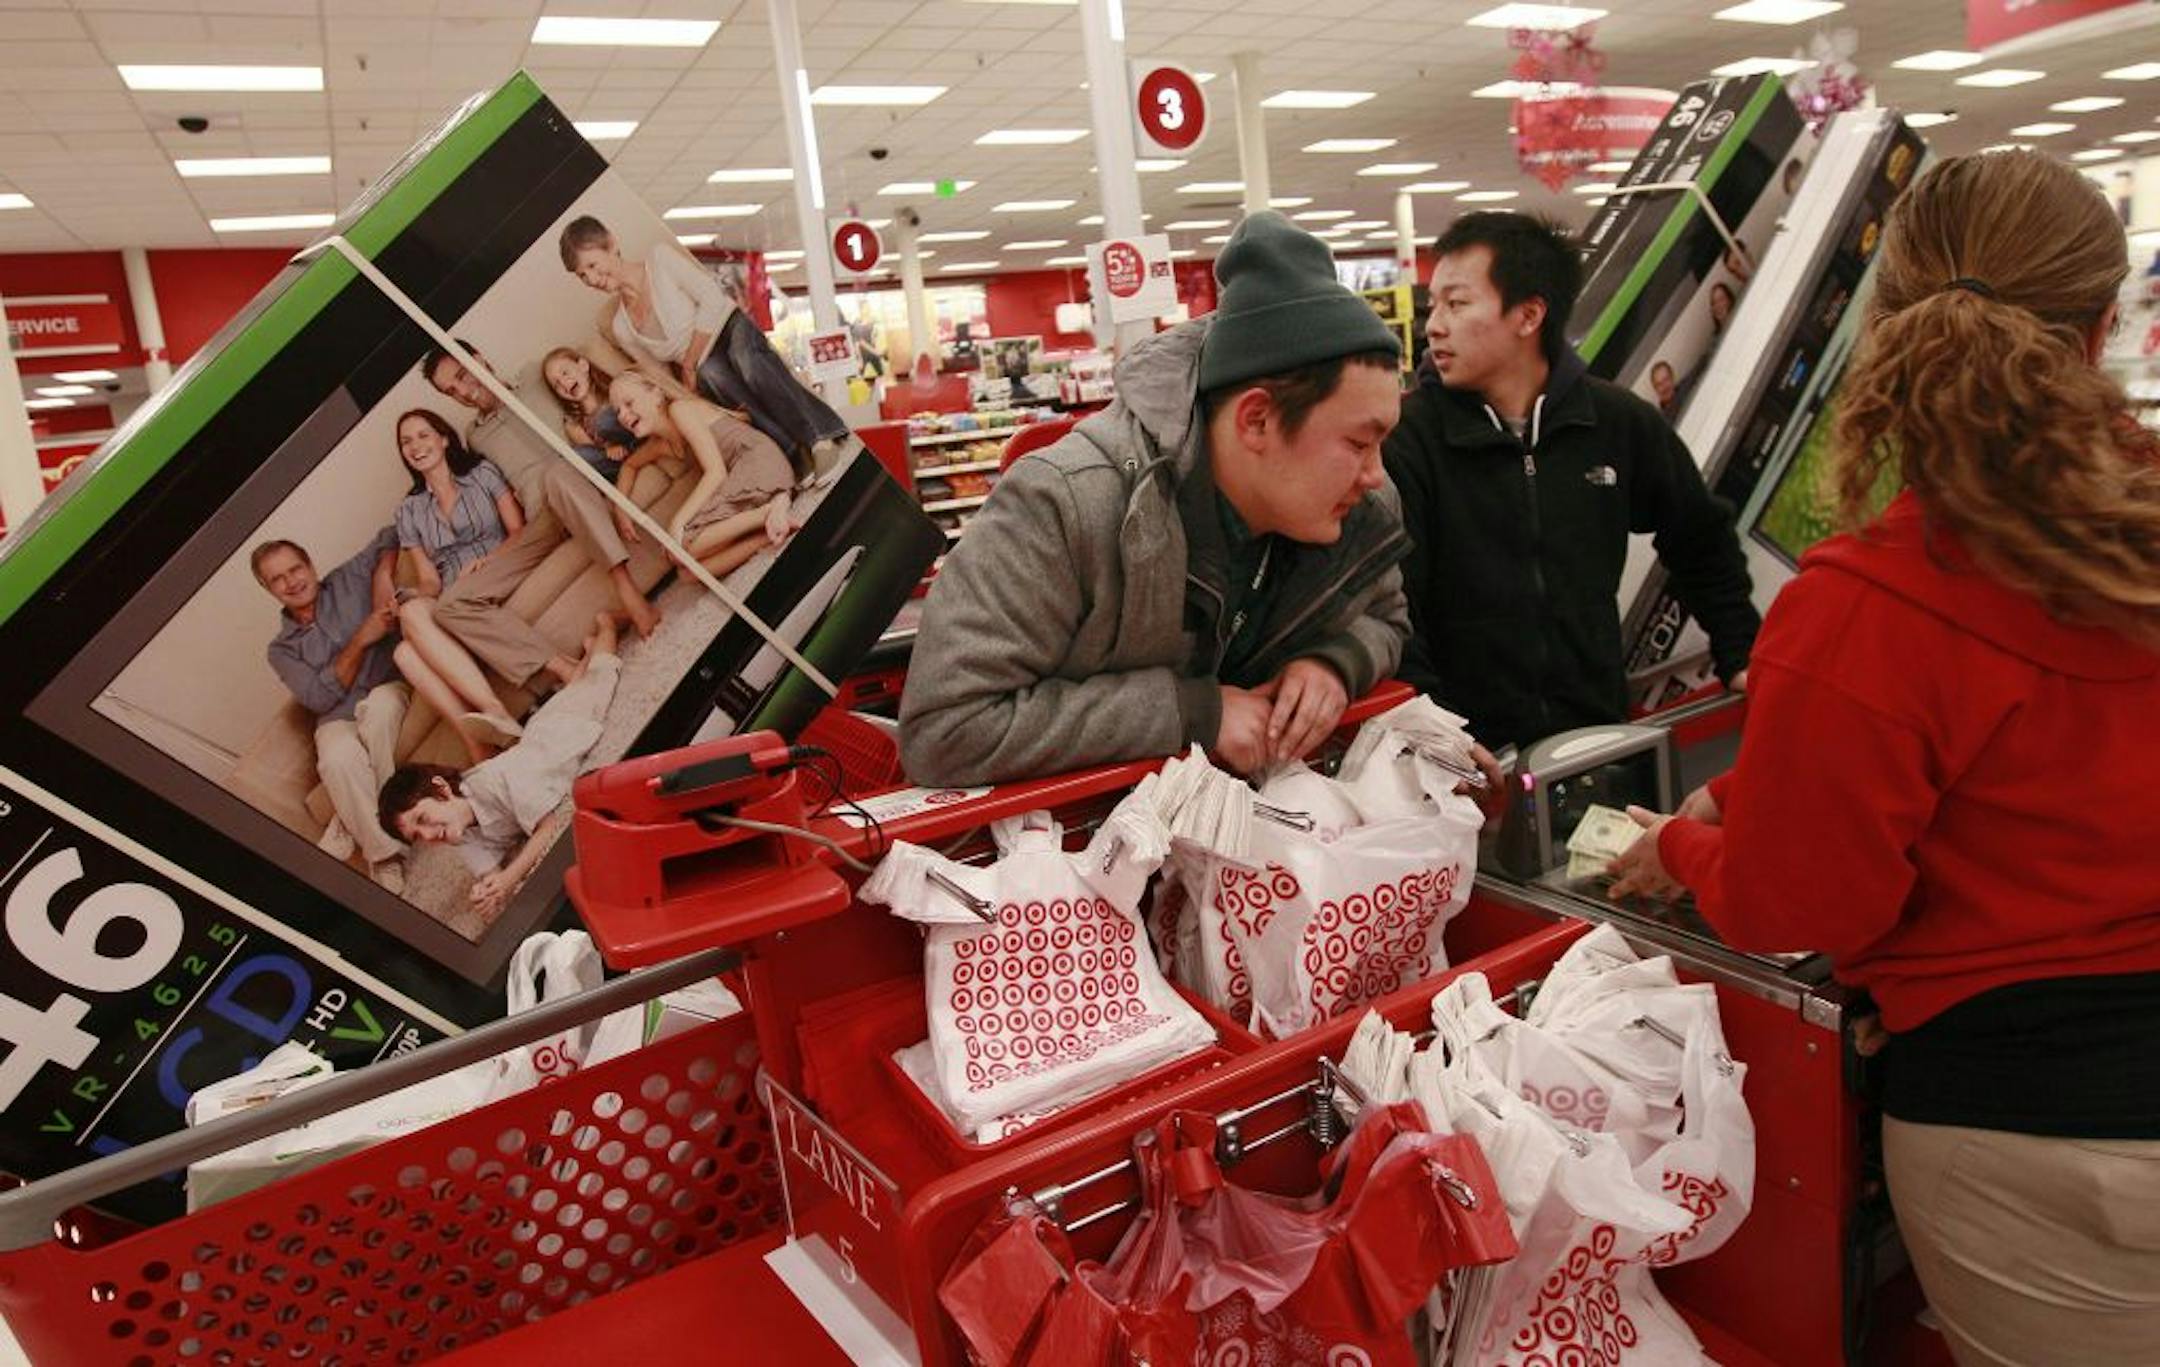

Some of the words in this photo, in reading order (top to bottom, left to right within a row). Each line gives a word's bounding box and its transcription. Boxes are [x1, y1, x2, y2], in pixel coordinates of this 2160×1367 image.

[1157, 88, 1185, 130] 3
[847, 233, 864, 261] 1
[8, 317, 80, 333] ERVICE
[304, 988, 348, 1031] HD
[90, 953, 312, 1157] CD
[786, 1106, 881, 1231] LANE
[838, 1235, 858, 1284] 5
